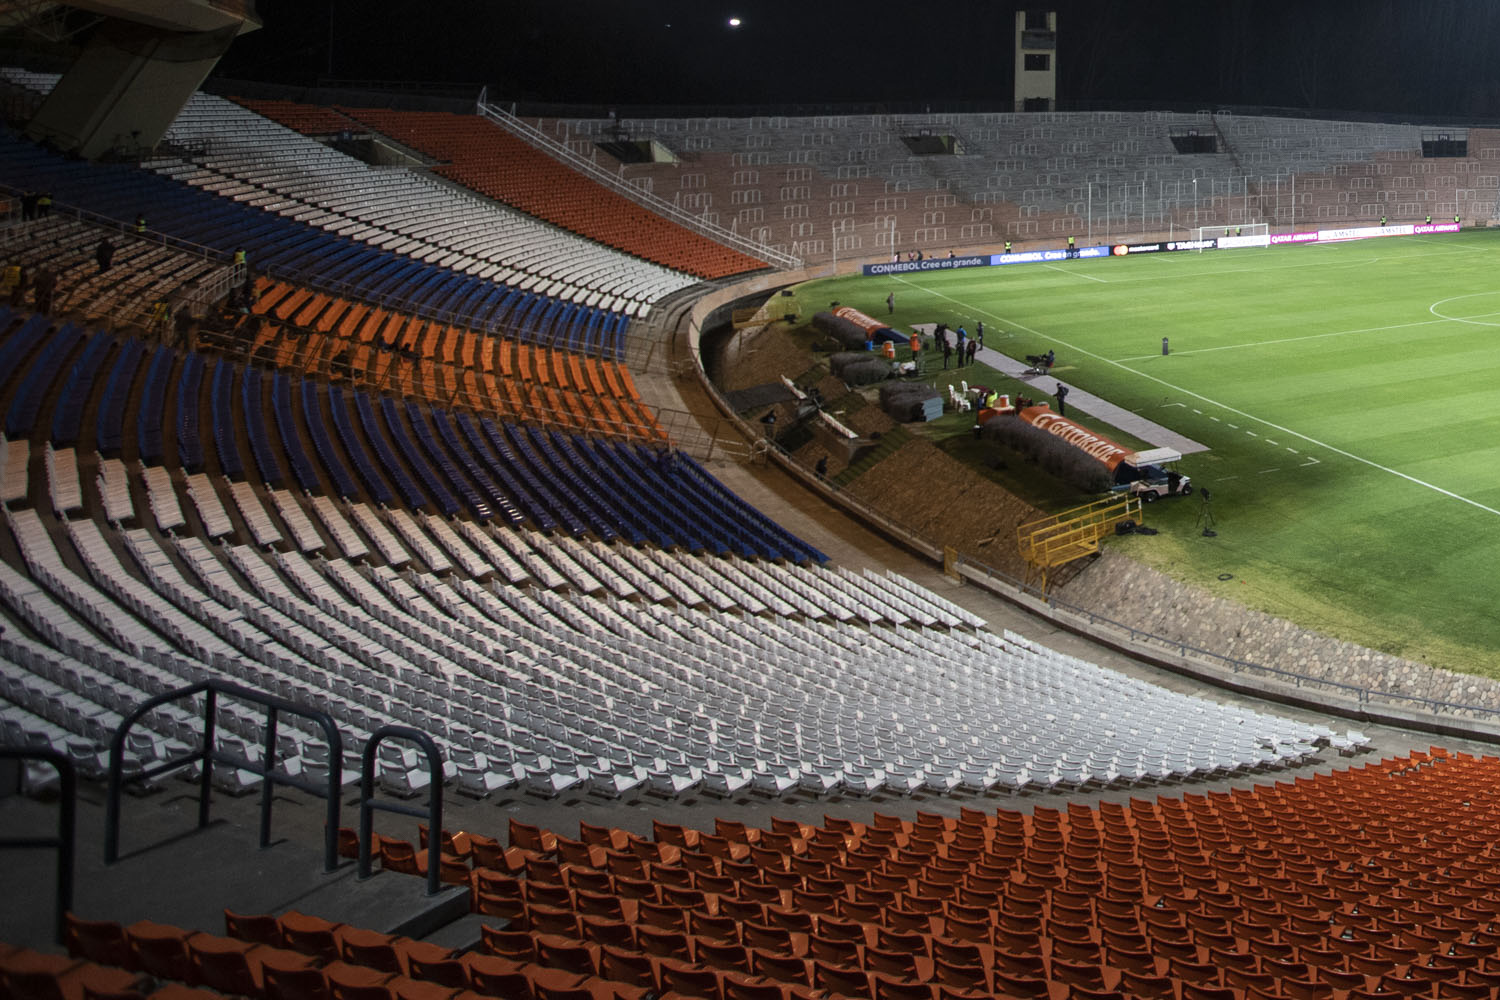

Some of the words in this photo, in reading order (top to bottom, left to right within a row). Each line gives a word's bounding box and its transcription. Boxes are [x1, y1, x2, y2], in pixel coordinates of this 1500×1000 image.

[871, 262, 920, 273] CONMEBOL
[921, 261, 940, 269] Cree
[1047, 422, 1126, 462] GATORADE
